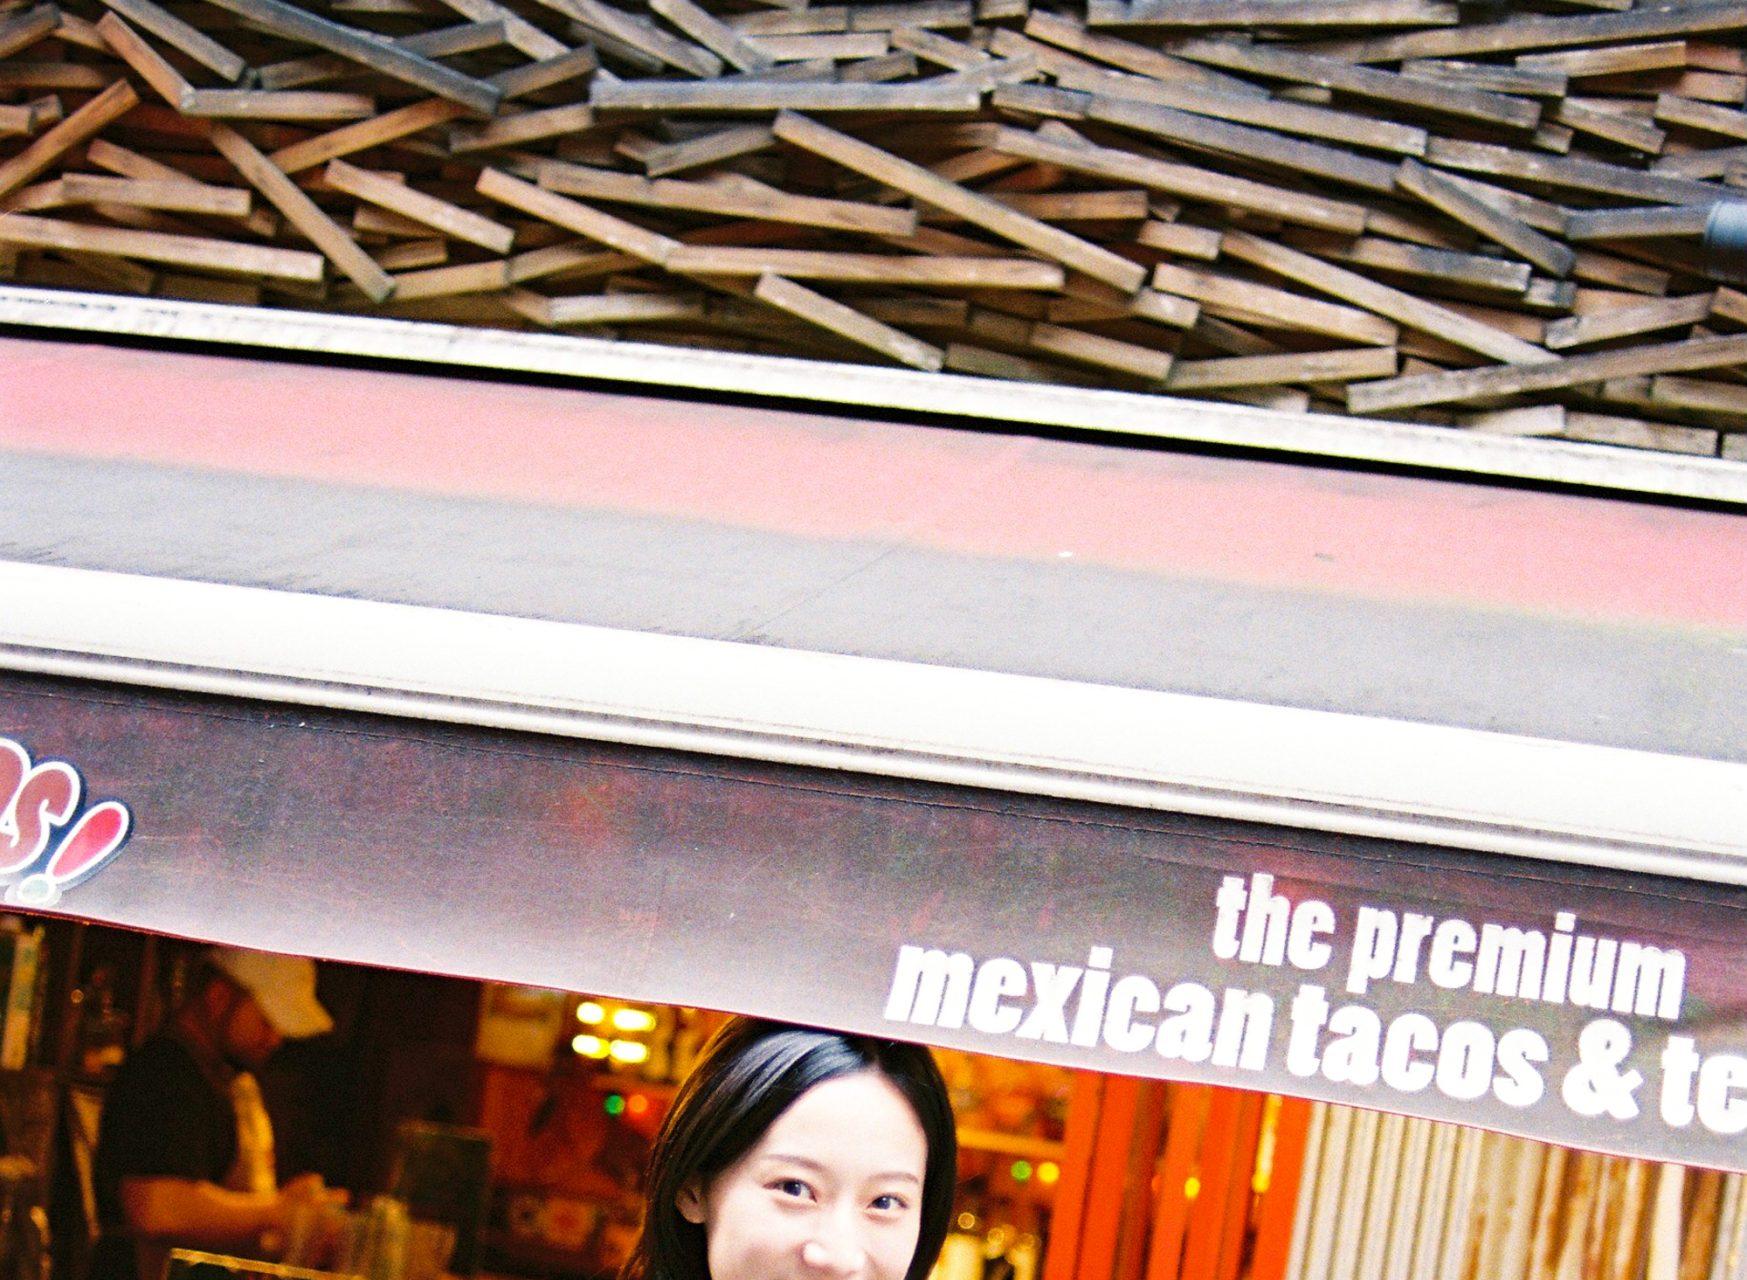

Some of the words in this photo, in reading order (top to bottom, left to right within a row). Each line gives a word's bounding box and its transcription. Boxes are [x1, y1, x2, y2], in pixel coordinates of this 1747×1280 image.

[1211, 872, 1336, 971] the
[1345, 903, 1688, 1021] premium
[882, 943, 1275, 1073] mexican
[1285, 983, 1550, 1109] tacos
[1561, 1018, 1645, 1120] &
